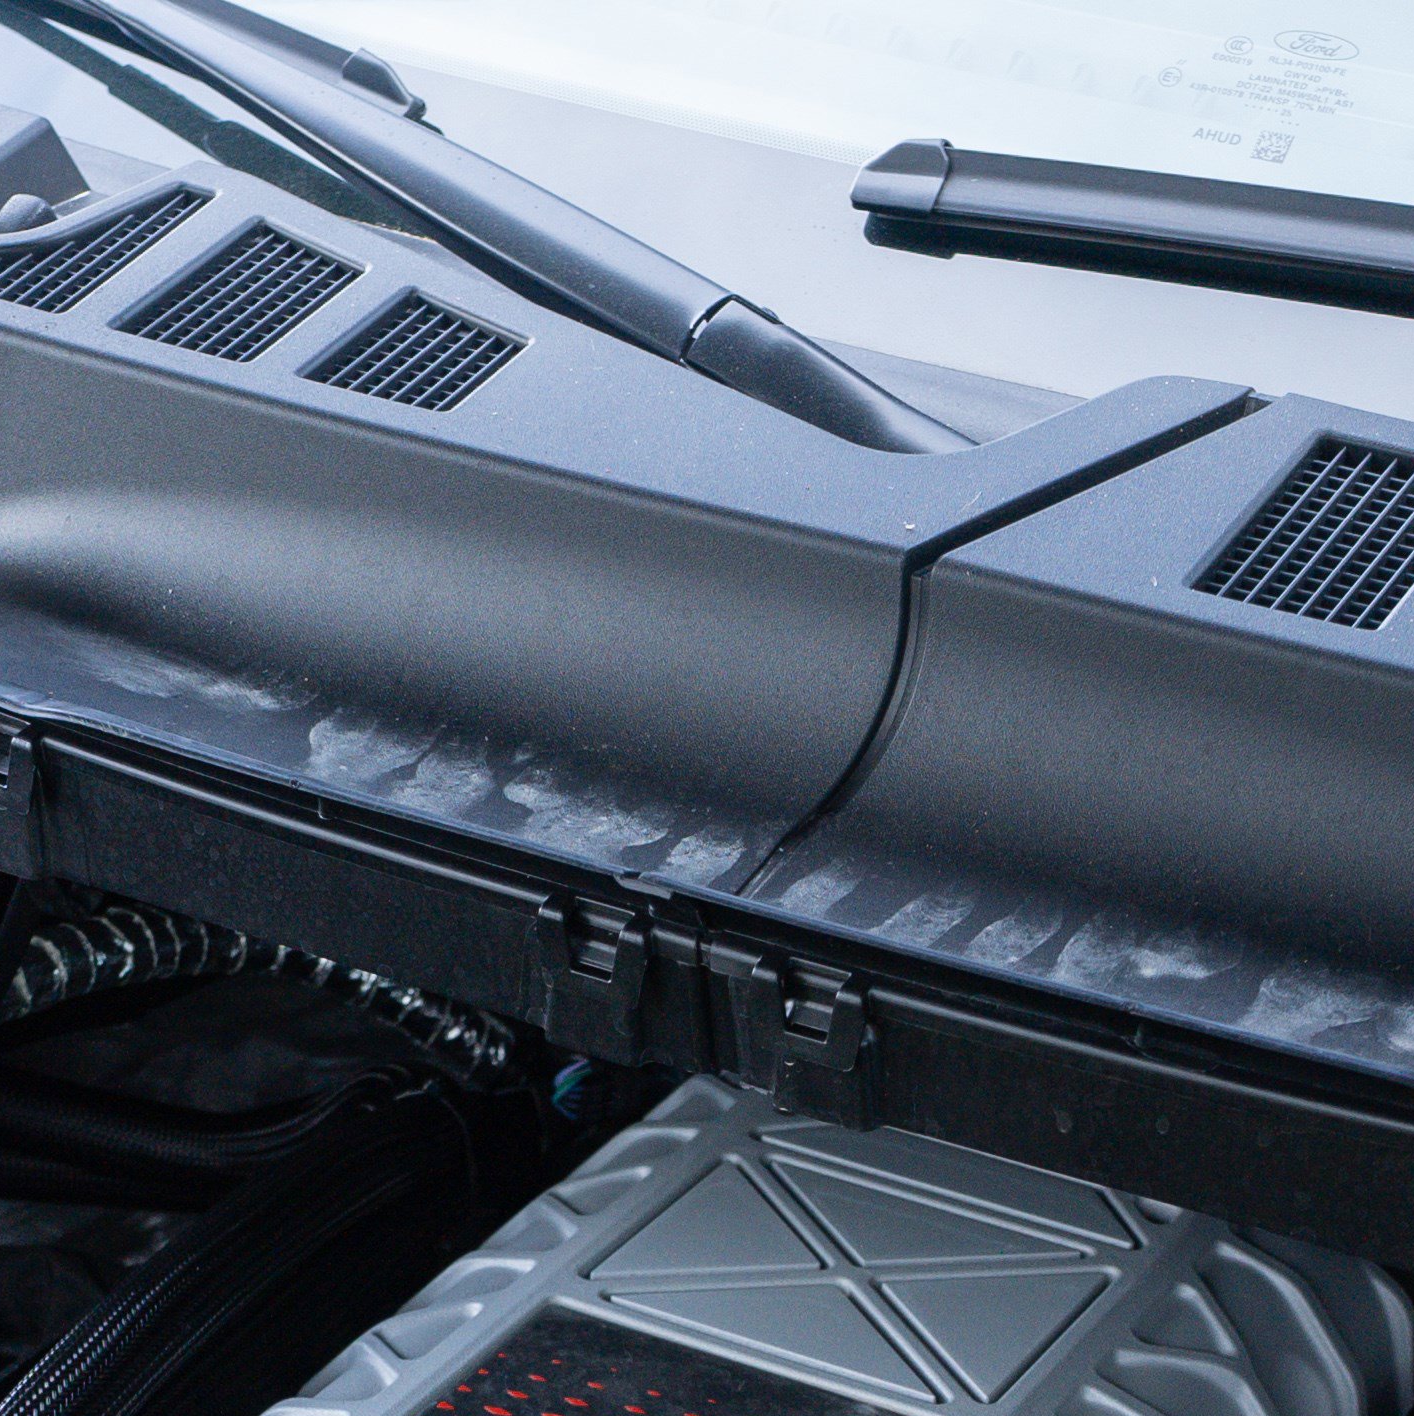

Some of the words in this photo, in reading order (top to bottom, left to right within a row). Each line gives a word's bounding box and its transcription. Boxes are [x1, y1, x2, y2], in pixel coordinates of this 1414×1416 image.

[1289, 33, 1344, 58] Ford
[1248, 73, 1308, 90] LAMINATED
[1192, 127, 1242, 146] AHUD
